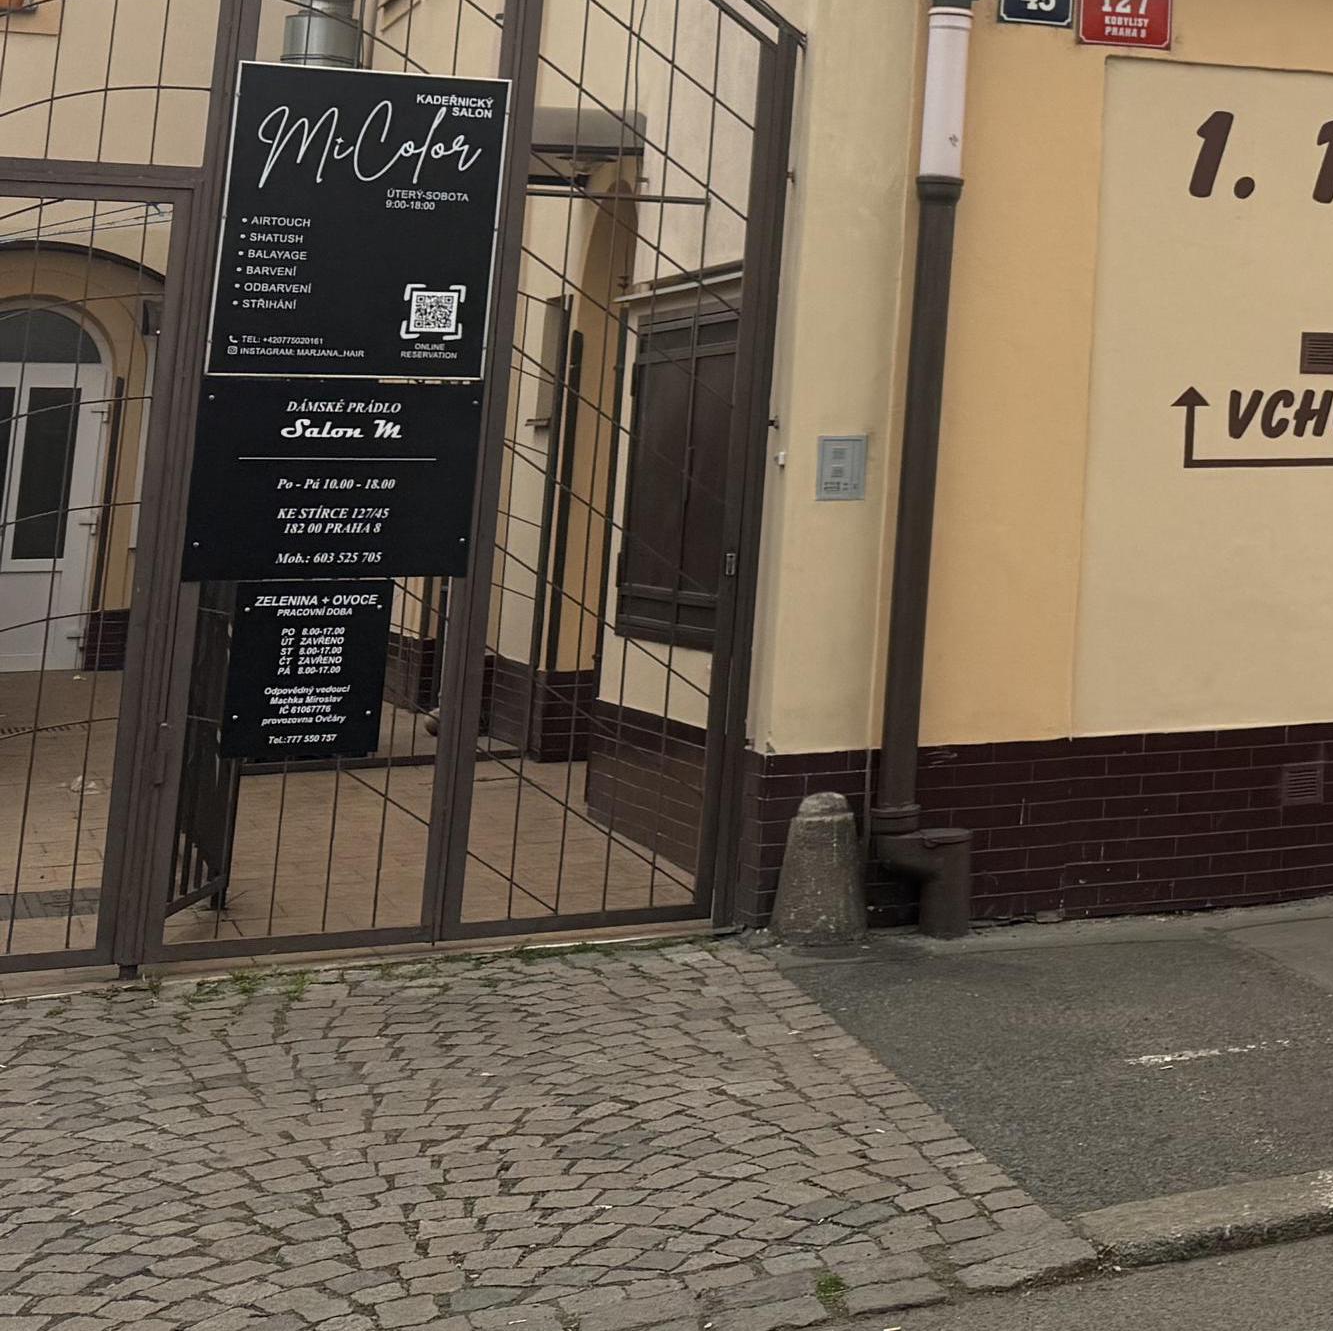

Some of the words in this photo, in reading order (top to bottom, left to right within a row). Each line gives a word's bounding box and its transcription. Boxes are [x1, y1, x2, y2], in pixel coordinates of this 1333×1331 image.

[416, 94, 494, 108] KADEŘNICKÝ
[452, 107, 493, 118] SALON
[1189, 111, 1255, 198] 1.
[387, 188, 469, 202] ÚTERÝ-SOBOTA
[385, 200, 436, 210] 9:00-18:00
[251, 216, 311, 228] AIRTOUCH
[249, 232, 304, 243] SHATUSH
[248, 249, 308, 260] BALAYAGE
[246, 266, 296, 276] BARVENÍ
[244, 282, 312, 294] ODBARVENÍ
[242, 298, 296, 310] STŘIHÁNÍ
[414, 342, 446, 351] ONLINE
[286, 398, 345, 412] DÁMSKÉ
[346, 399, 402, 414] PRÁDLO
[280, 418, 364, 438] Salon
[373, 419, 402, 438] M
[277, 479, 294, 490] Po
[304, 478, 320, 490] Pá
[323, 479, 354, 490] 10.00
[365, 479, 396, 490] 18.00
[277, 508, 297, 518] KE
[298, 506, 350, 519] STÍRCE
[351, 508, 390, 519] 127/45
[284, 523, 305, 534] 182
[308, 523, 322, 534] 00
[324, 523, 370, 534] PRAHA
[373, 523, 382, 533] 8
[276, 553, 310, 564] Mob.:
[313, 553, 334, 564] 603
[336, 552, 359, 563] 525
[362, 552, 383, 563] 705
[255, 596, 318, 606] ZELENINA
[321, 596, 330, 604] +
[332, 594, 378, 606] OVOCE
[277, 606, 325, 616] PRACOVNÍ
[326, 608, 352, 616] DOBA
[281, 628, 296, 636] PO
[302, 628, 345, 636] 8.00-17.00
[280, 636, 294, 646] ÚT
[300, 636, 344, 646] ZAVŘENO
[280, 648, 294, 656] ST
[278, 656, 293, 665] ČT
[298, 656, 342, 664] ZAVŘENO
[278, 666, 292, 675] PÁ
[298, 666, 342, 674] 8.00-17.00
[264, 686, 315, 696] Odpovědný
[316, 684, 351, 693] vedoucí
[305, 695, 344, 704] Miroslav
[278, 705, 290, 714] IČ
[261, 717, 313, 726] provozovna
